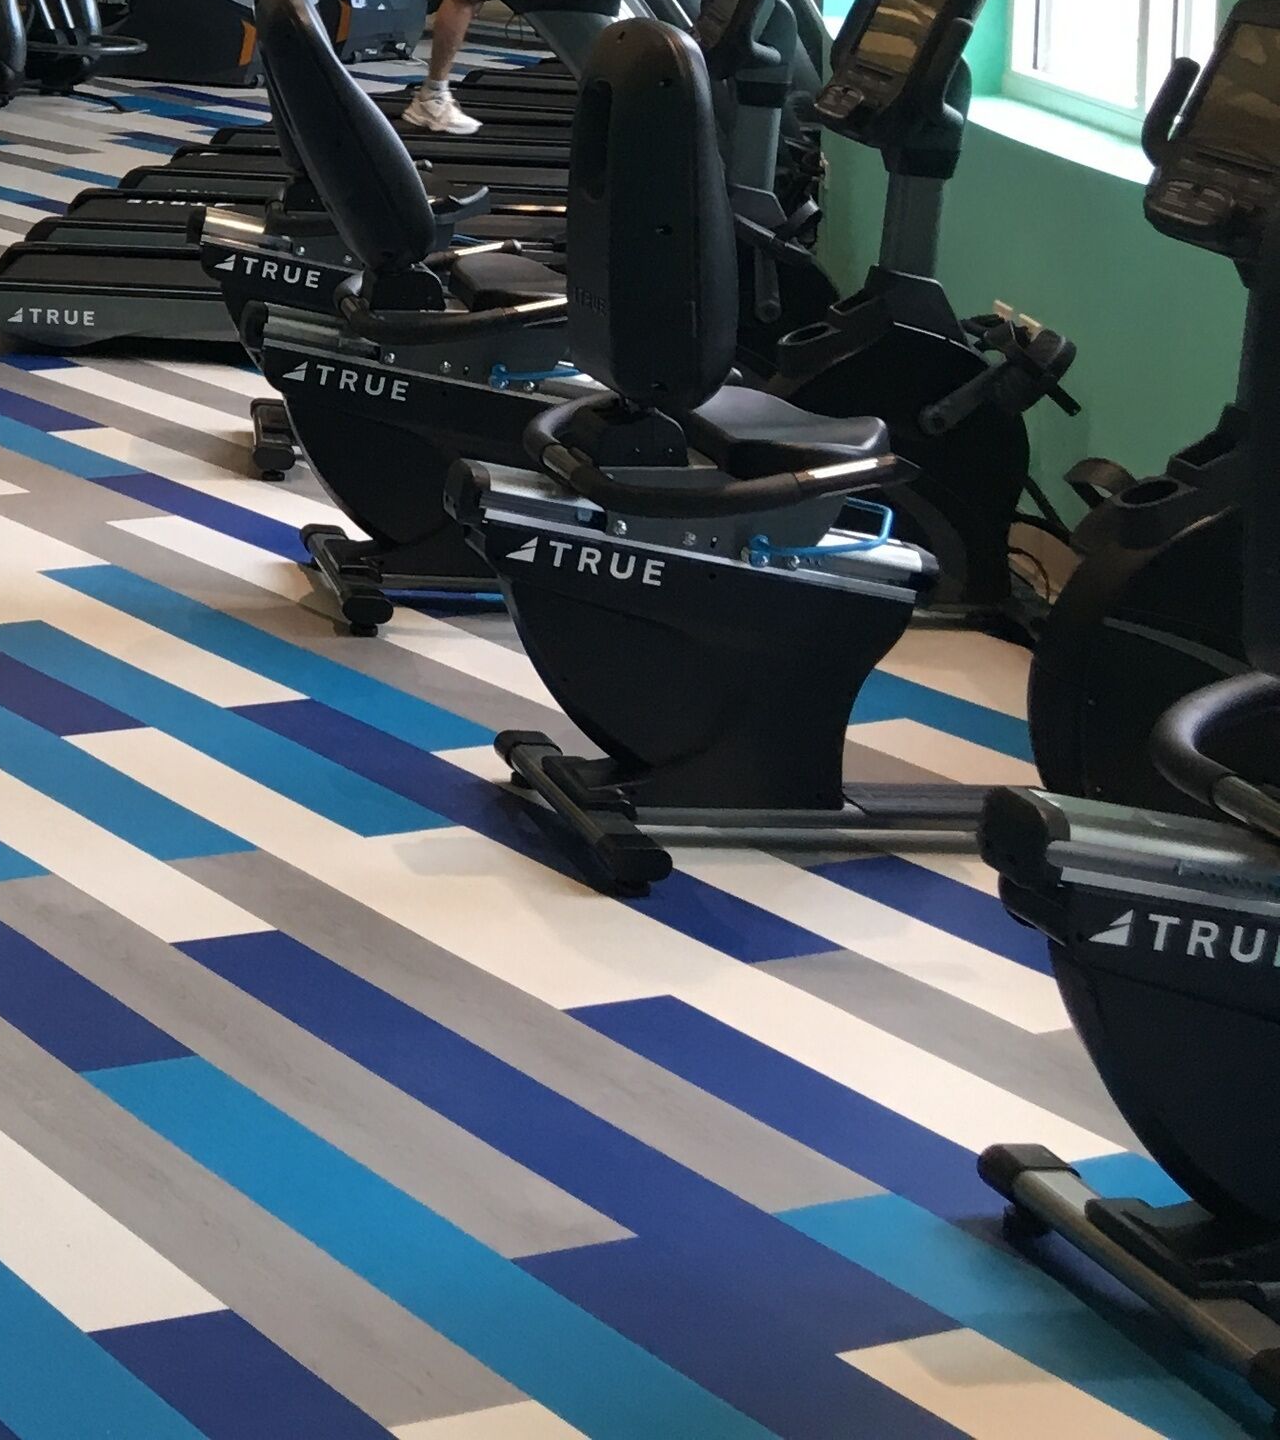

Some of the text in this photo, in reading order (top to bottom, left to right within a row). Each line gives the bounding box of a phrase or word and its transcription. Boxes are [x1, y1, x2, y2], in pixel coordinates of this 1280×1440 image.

[242, 256, 321, 288] TRUE
[28, 308, 96, 326] TRUE
[317, 364, 409, 401] TRUE
[549, 540, 666, 587] TRUE
